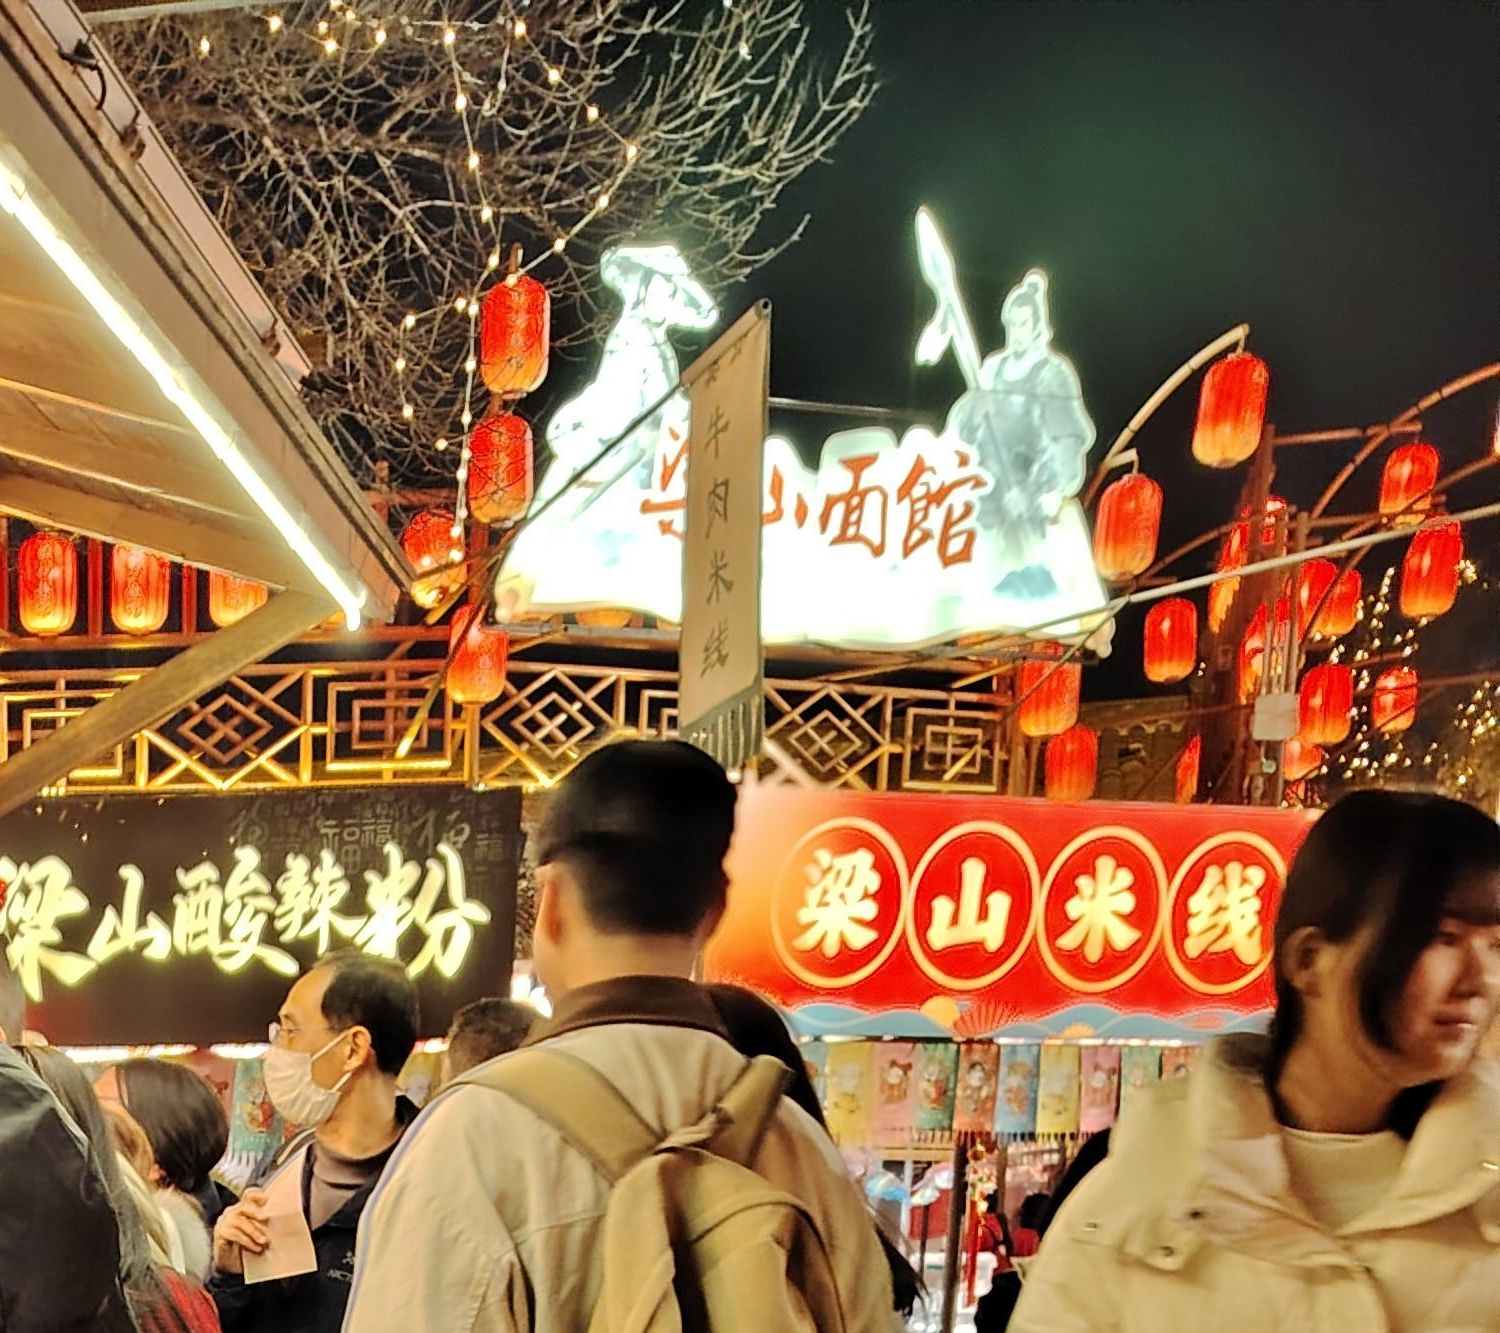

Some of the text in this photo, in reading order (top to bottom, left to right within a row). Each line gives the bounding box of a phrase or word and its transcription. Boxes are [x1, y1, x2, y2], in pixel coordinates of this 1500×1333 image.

[699, 405, 734, 678] 牛肉米线
[792, 848, 1266, 966] 梁山米线
